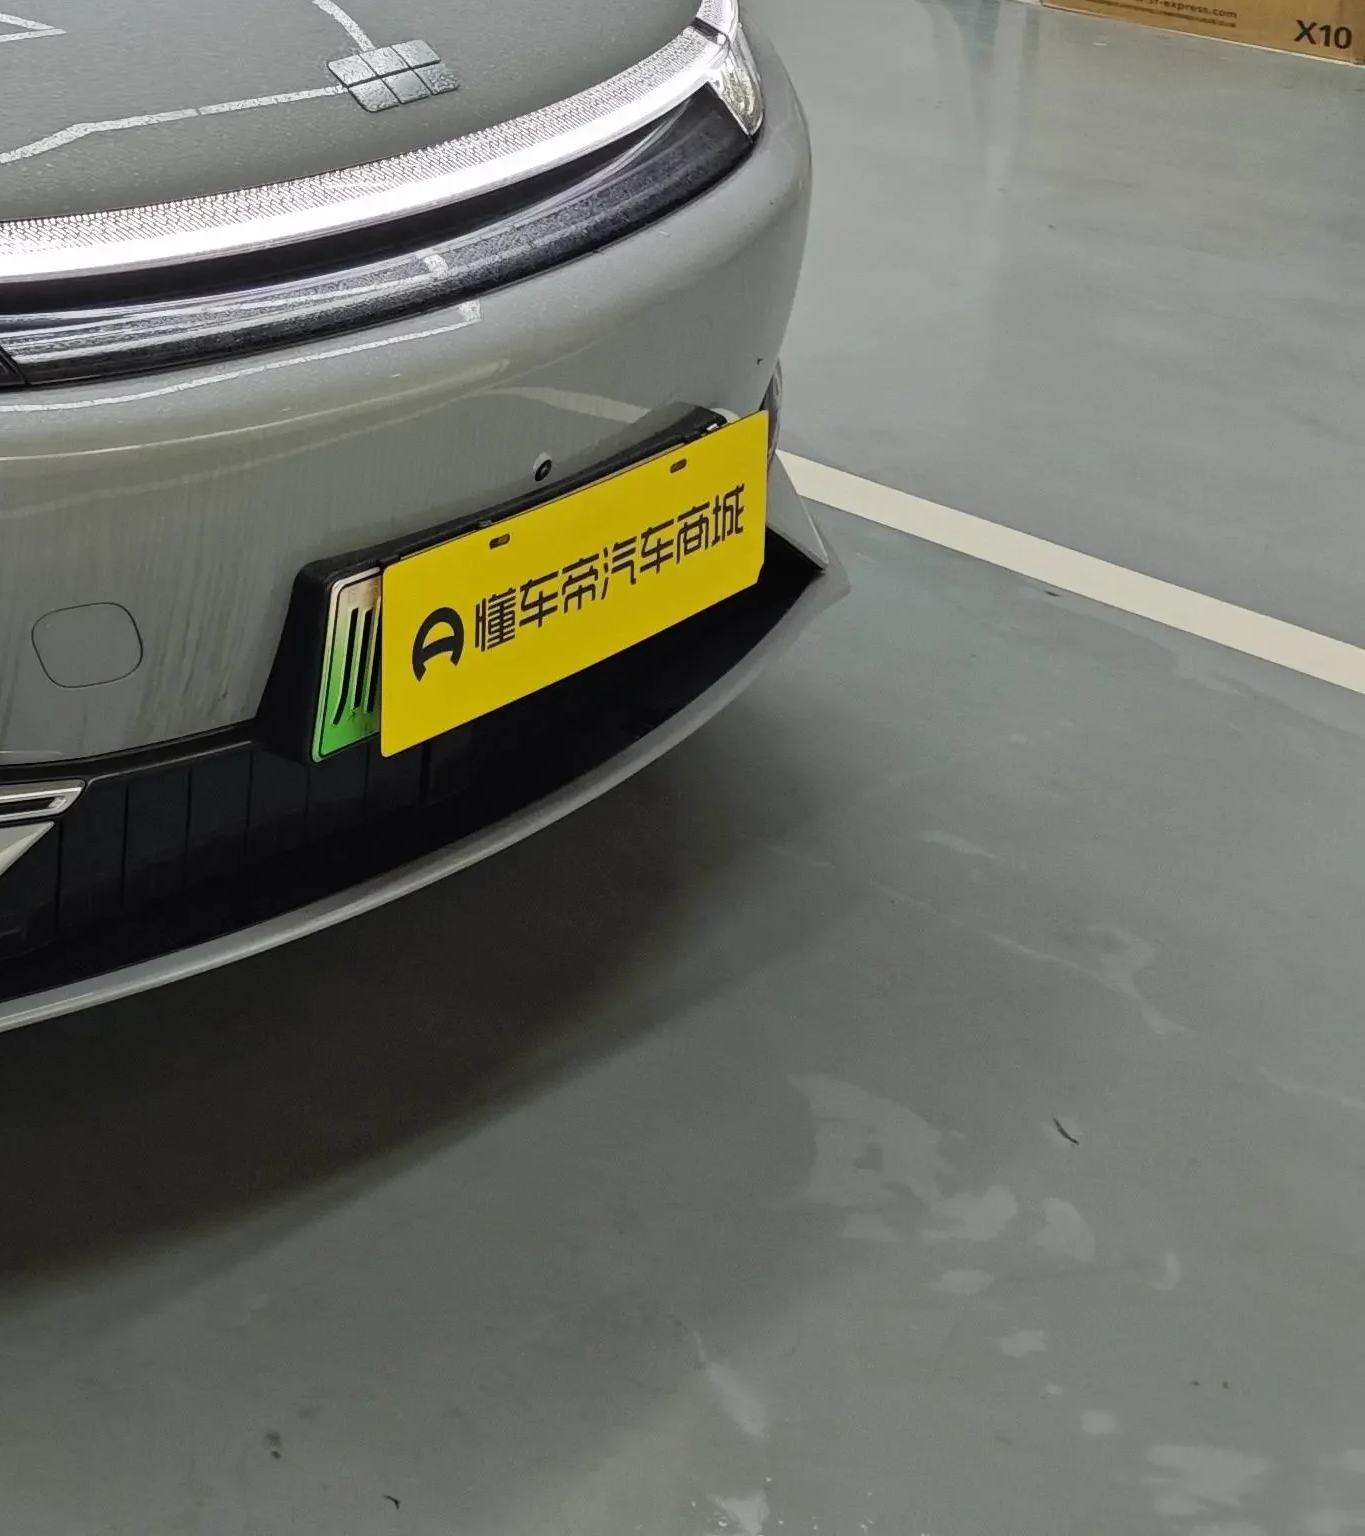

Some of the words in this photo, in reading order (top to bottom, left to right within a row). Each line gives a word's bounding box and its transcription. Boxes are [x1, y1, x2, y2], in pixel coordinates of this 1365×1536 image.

[1294, 19, 1352, 49] X10
[474, 482, 744, 652] 懂车帝汽车商城
